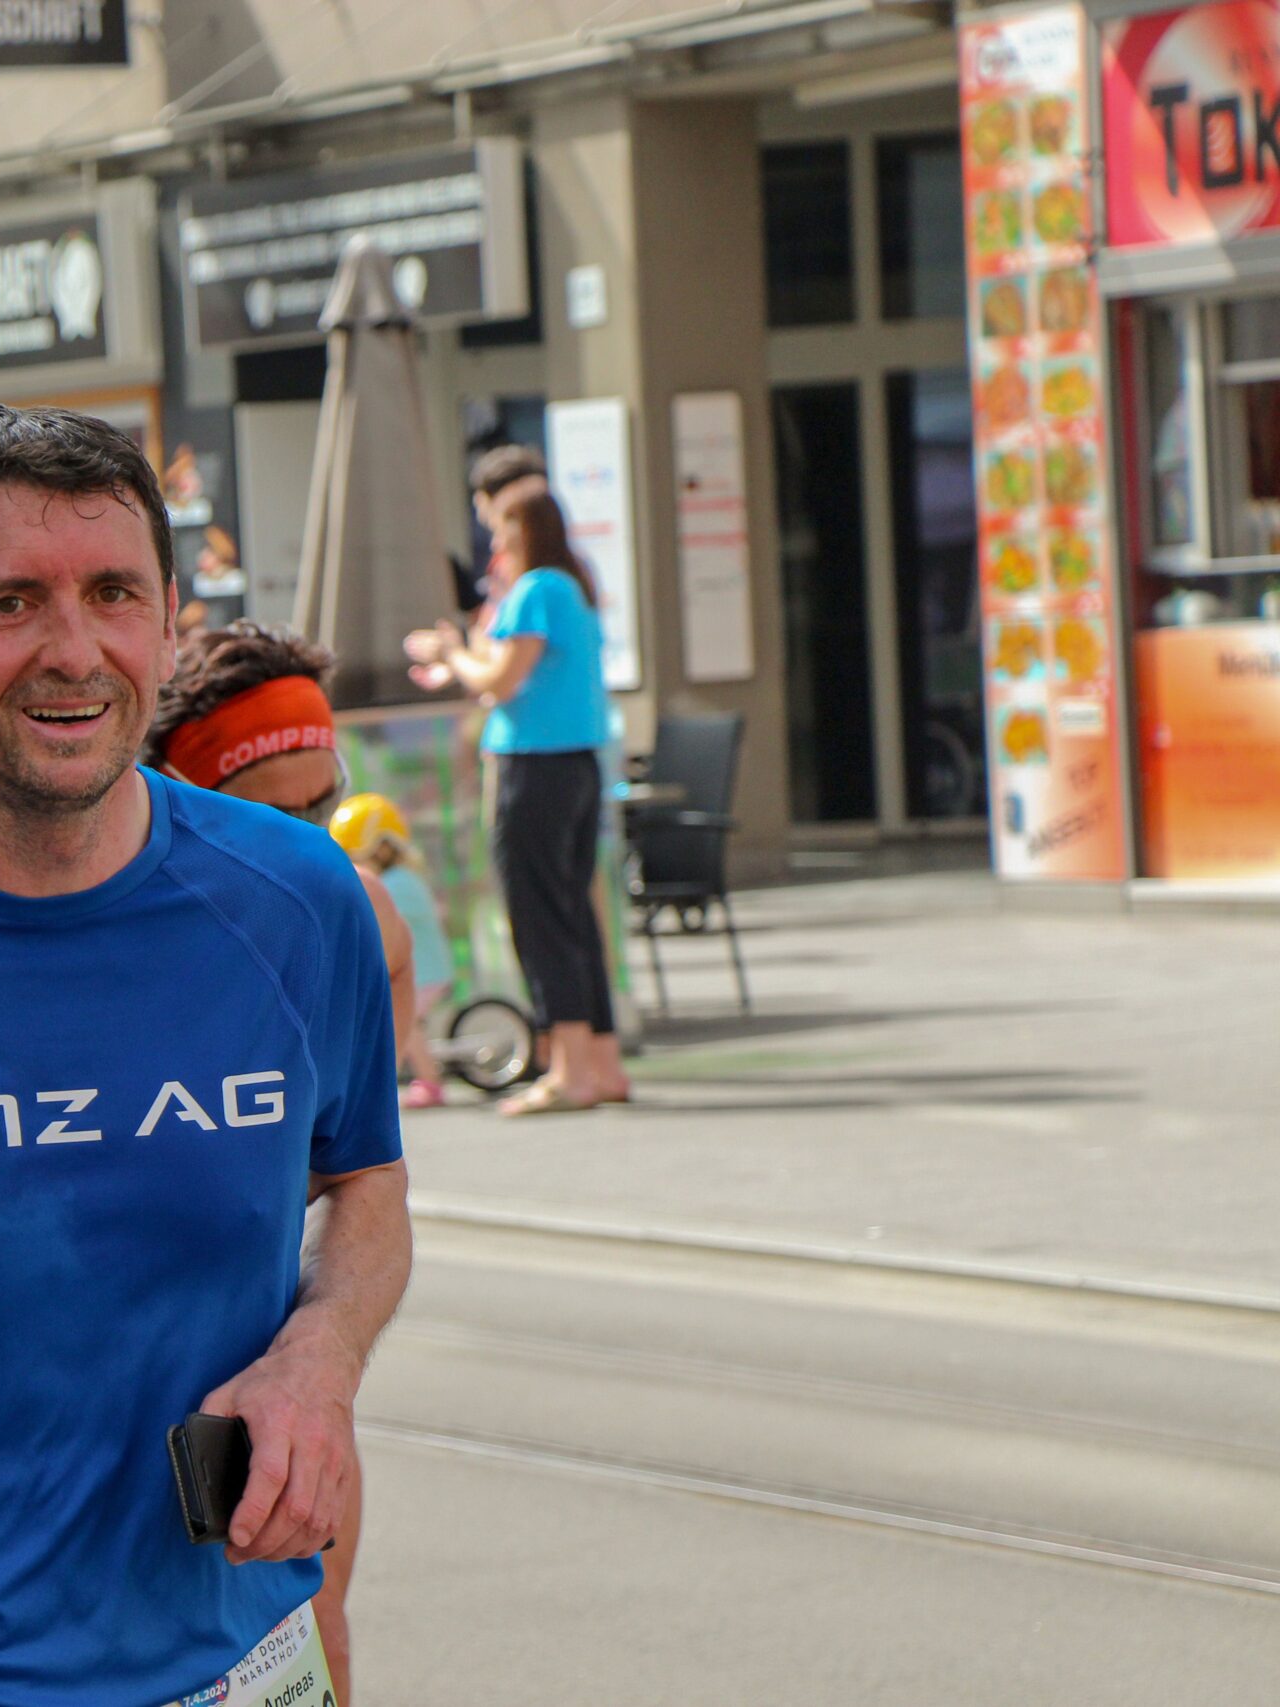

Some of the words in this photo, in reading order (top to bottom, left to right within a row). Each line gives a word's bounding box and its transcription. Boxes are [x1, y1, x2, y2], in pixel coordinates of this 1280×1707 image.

[219, 726, 336, 775] COMPRE
[135, 1070, 285, 1137] AG
[264, 1671, 314, 1707] Andreas
